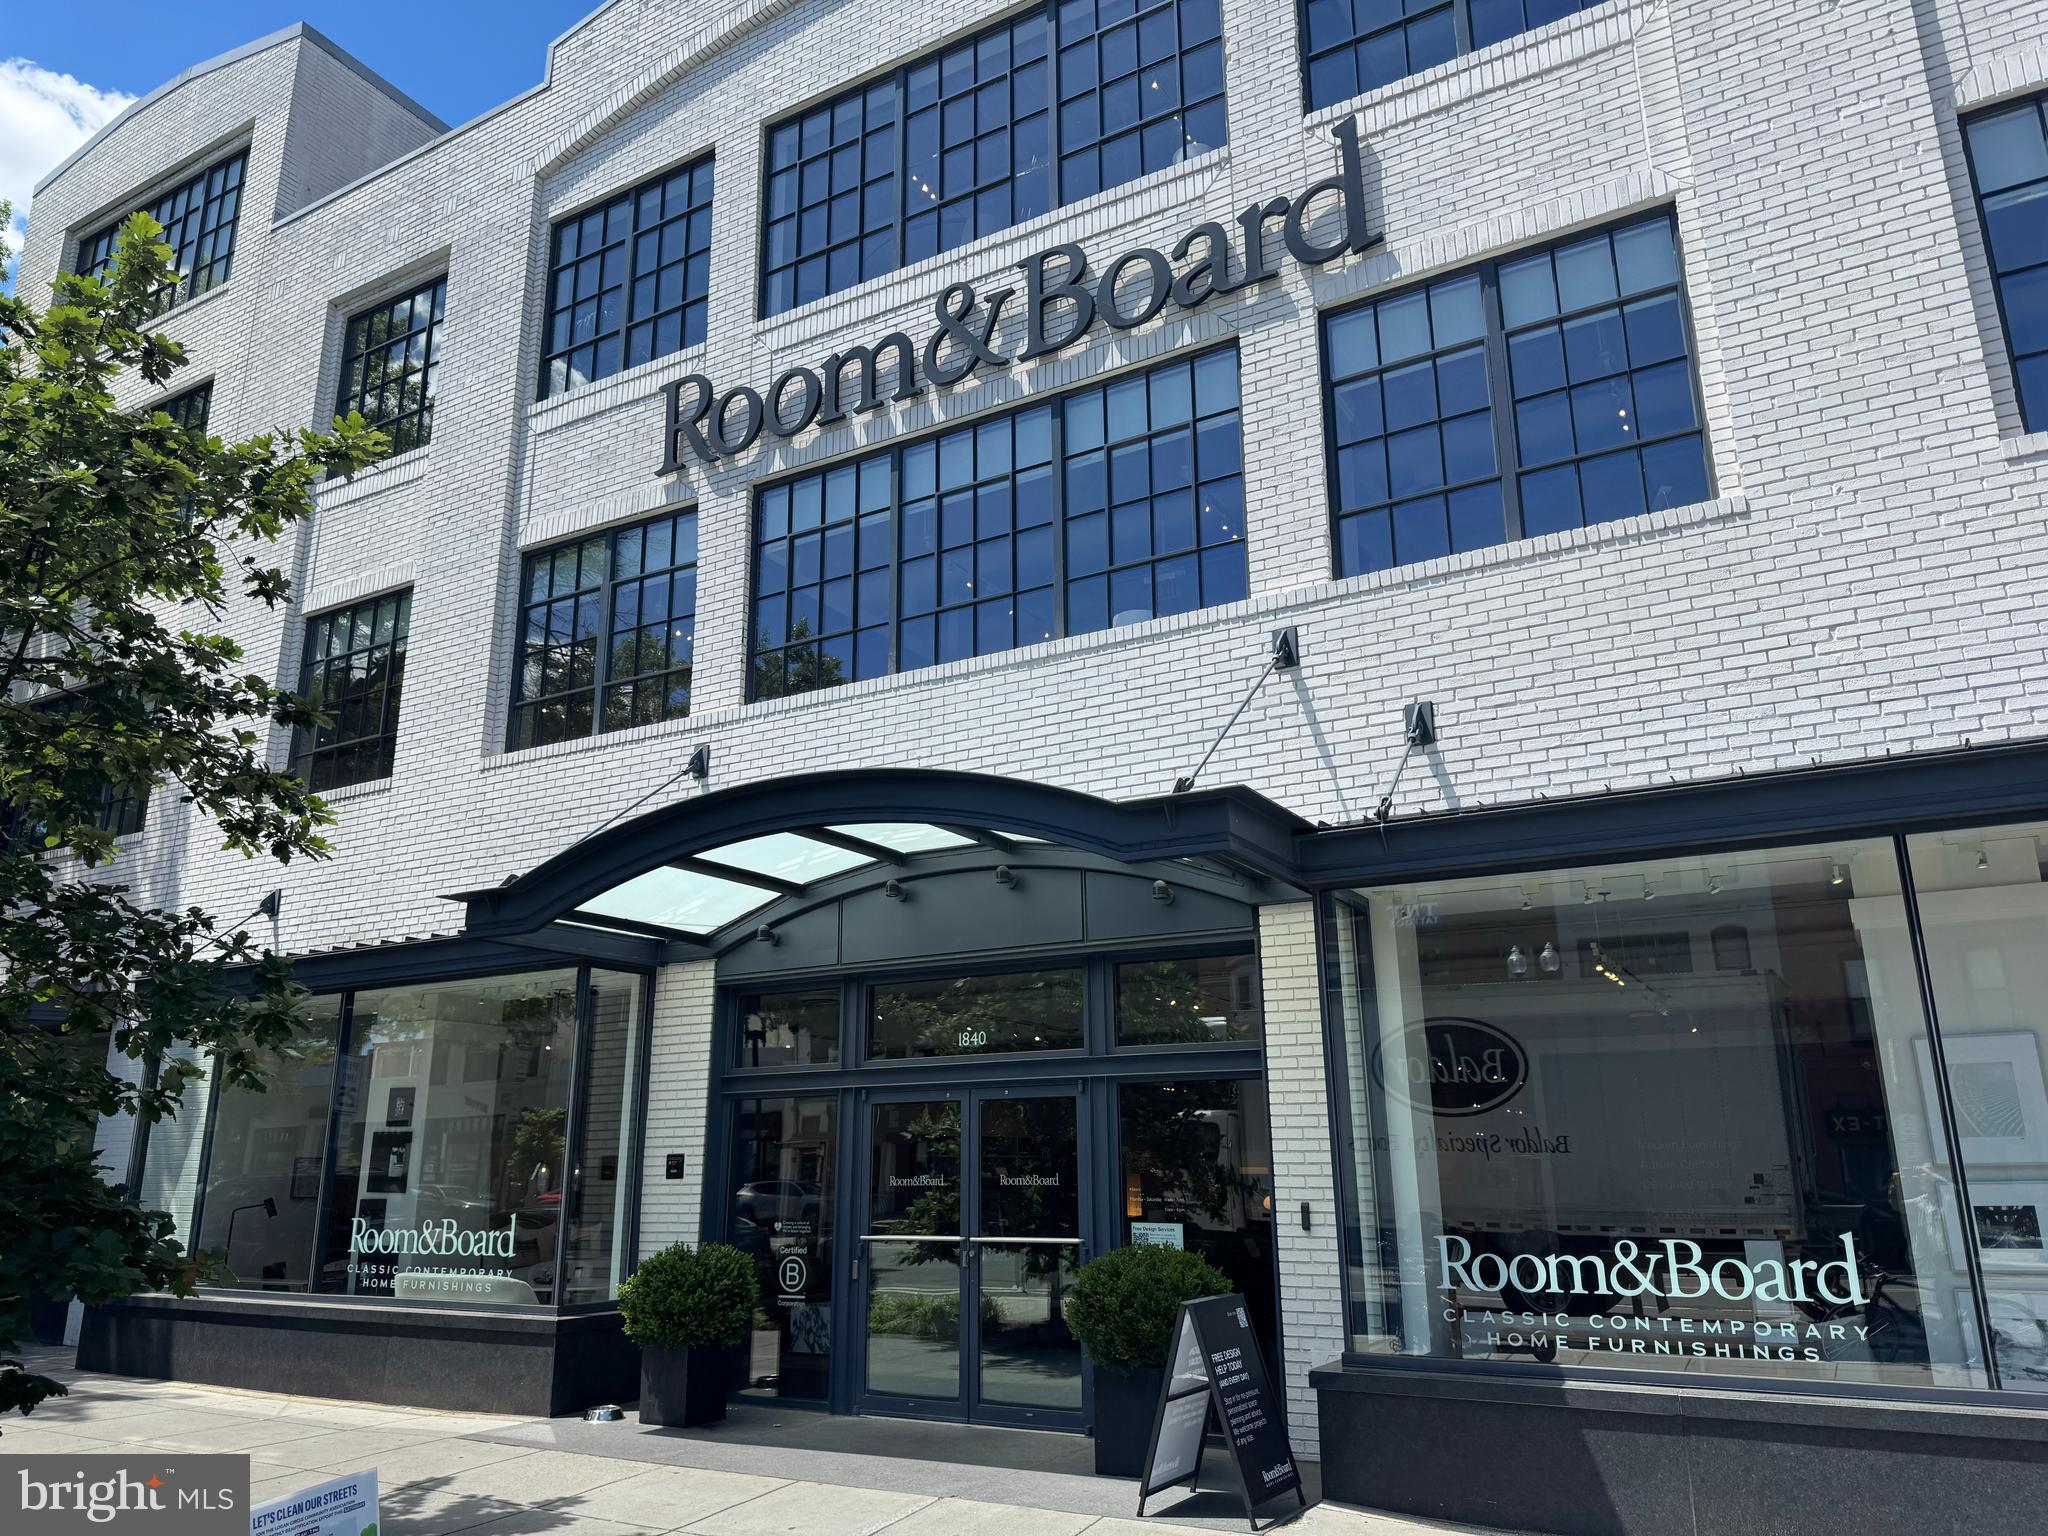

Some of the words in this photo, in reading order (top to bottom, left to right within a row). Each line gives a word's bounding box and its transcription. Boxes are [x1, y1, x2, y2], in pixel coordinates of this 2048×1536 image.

[654, 114, 1384, 478] Room&Board
[959, 1031, 987, 1046] 1840
[889, 1174, 944, 1186] Room&Board
[1000, 1173, 1060, 1186] Room&Board
[348, 1212, 517, 1258] Room&Board
[780, 1246, 808, 1254] Certified
[347, 1264, 399, 1275] CLASSIC
[786, 1263, 799, 1285] B
[1433, 1231, 1871, 1306] Room&Board
[362, 1278, 396, 1289] HOME
[402, 1280, 492, 1293] FURNISHINGS
[1443, 1308, 1572, 1328] CLASSIC
[1589, 1314, 1870, 1341] CONTEMPORARY
[1211, 1351, 1224, 1363] FREE
[1223, 1347, 1242, 1360] DESIGN
[1487, 1332, 1570, 1350] HOME
[1588, 1336, 1821, 1362] FURNISHINGS
[1214, 1364, 1227, 1375] HELP
[1227, 1359, 1243, 1371] TODAY
[1262, 1457, 1292, 1483] Room&Board
[252, 1511, 275, 1530] LET'S
[276, 1503, 304, 1521] CLEAN
[305, 1495, 322, 1511] OUR
[323, 1484, 358, 1506] STREETS
